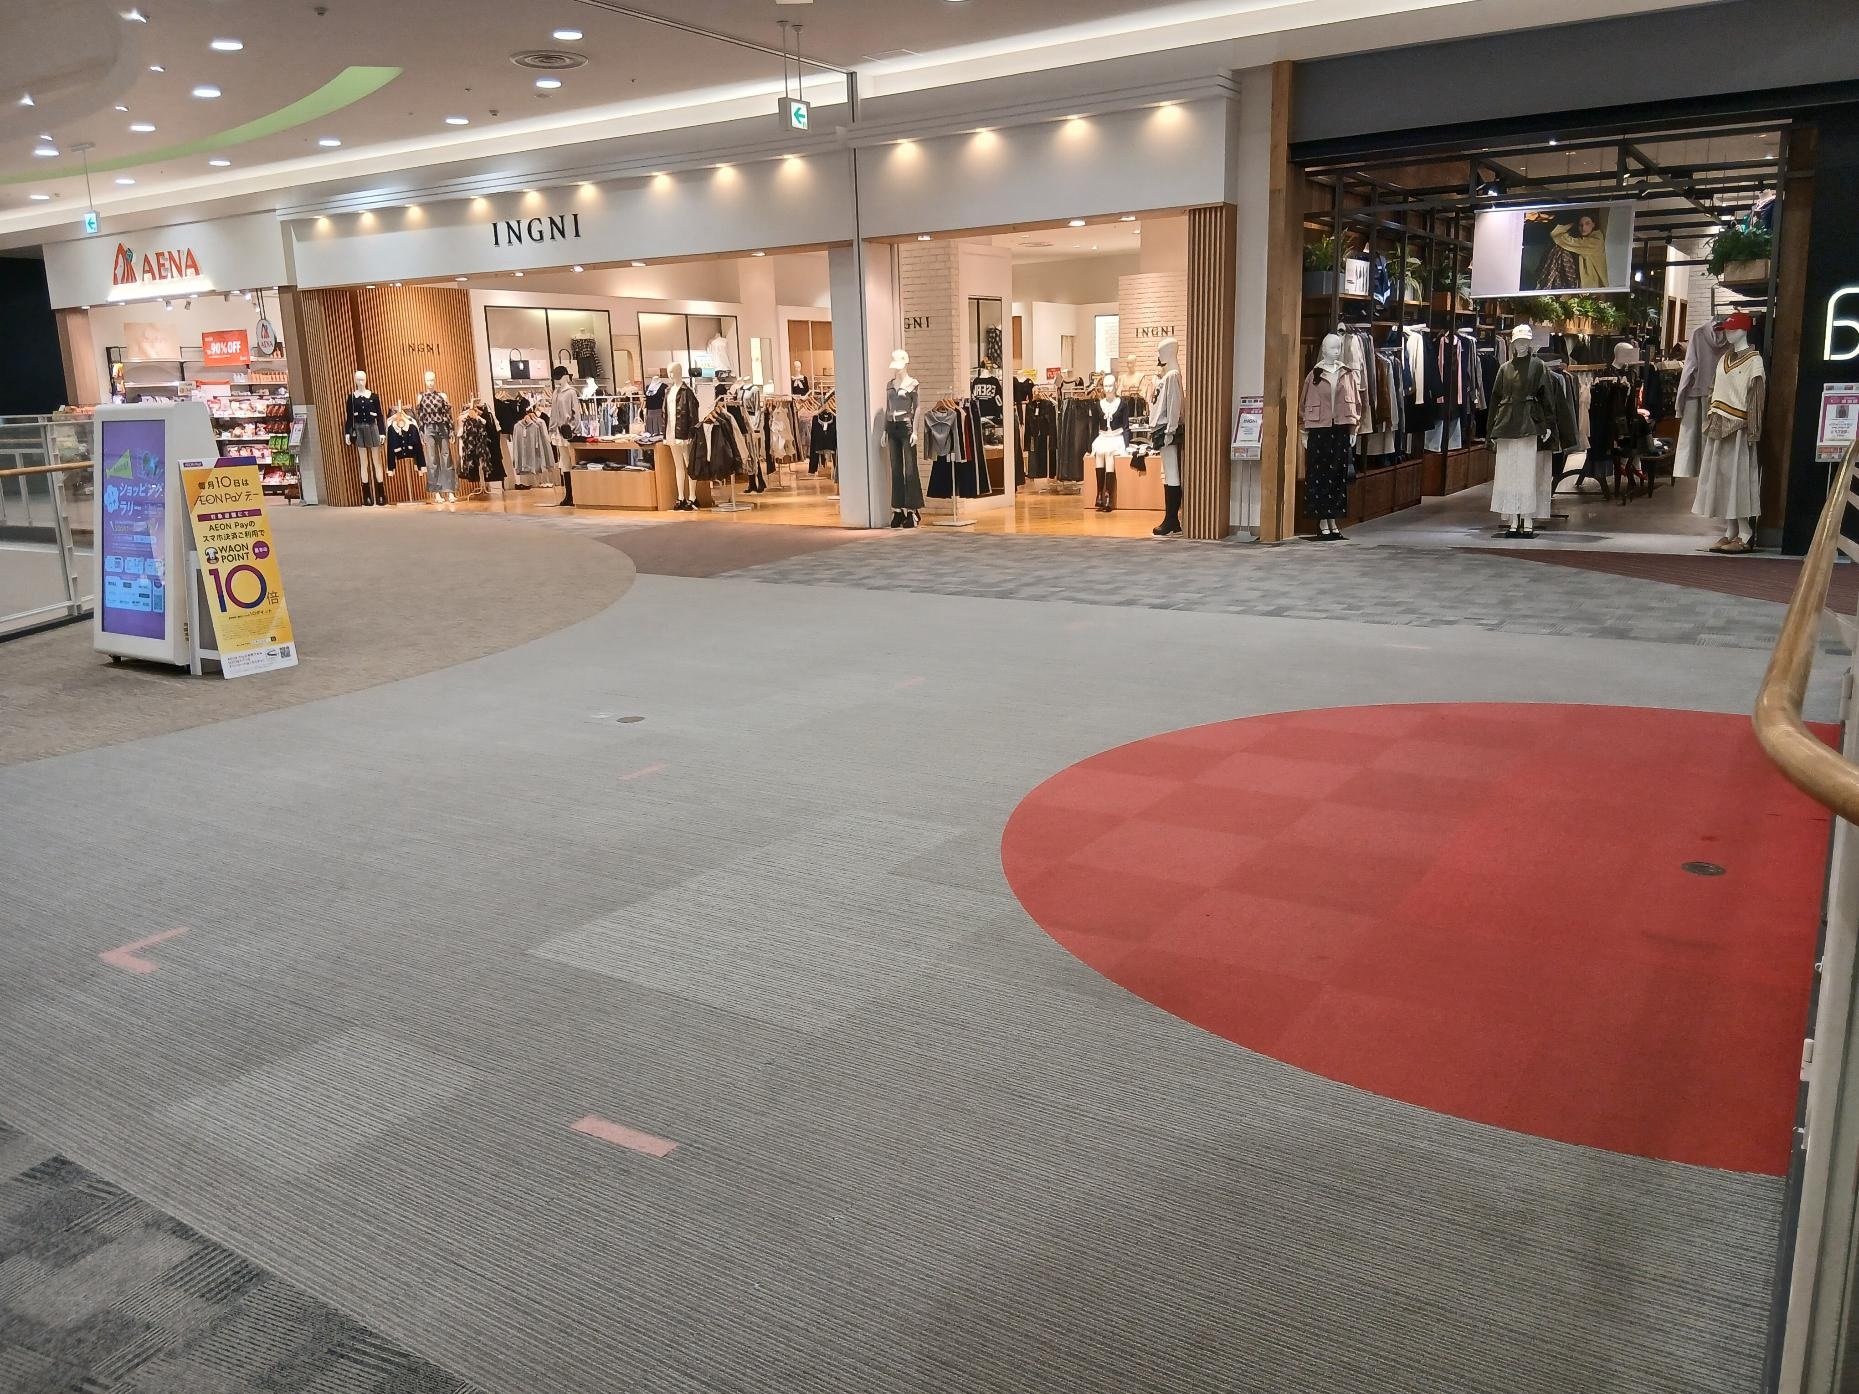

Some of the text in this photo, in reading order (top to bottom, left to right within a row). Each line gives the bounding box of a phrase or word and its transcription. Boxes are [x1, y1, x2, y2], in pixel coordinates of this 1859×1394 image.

[491, 213, 581, 247] INGNI
[142, 248, 200, 281] AENA
[1135, 326, 1174, 338] INGNI
[209, 523, 232, 532] AEON
[218, 543, 249, 554] WAON
[221, 552, 250, 563] POINT
